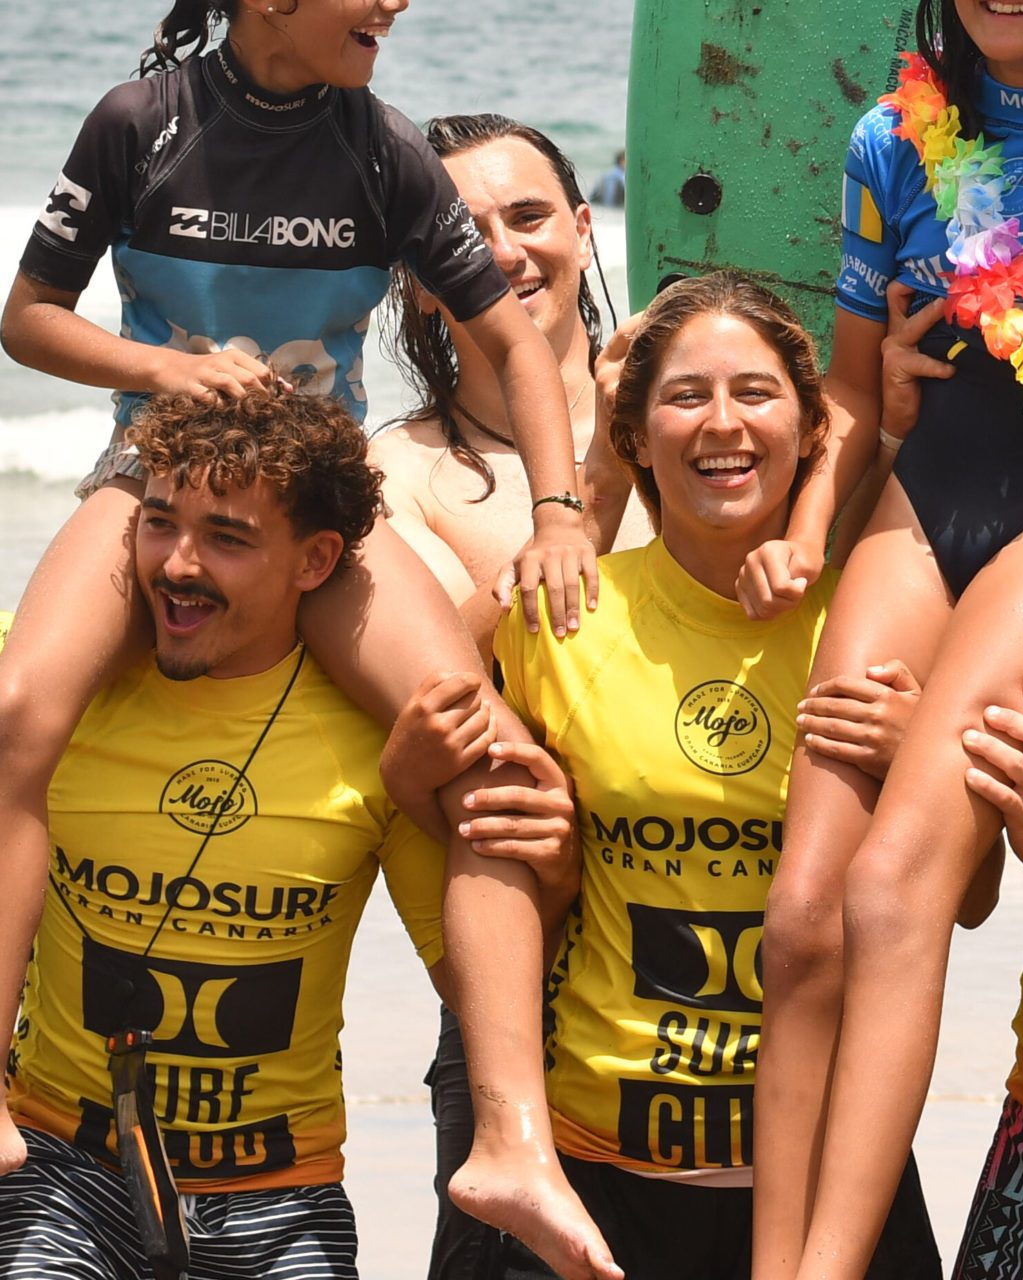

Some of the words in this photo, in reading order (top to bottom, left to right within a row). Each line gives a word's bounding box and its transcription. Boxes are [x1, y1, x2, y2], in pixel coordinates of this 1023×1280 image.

[210, 212, 356, 249] BILLABONG
[687, 691, 707, 708] MADE
[683, 706, 758, 748] Mojo
[176, 770, 196, 785] MADE
[601, 848, 682, 877] GRAN
[650, 1010, 763, 1077] SUR
[150, 1062, 260, 1124] URF
